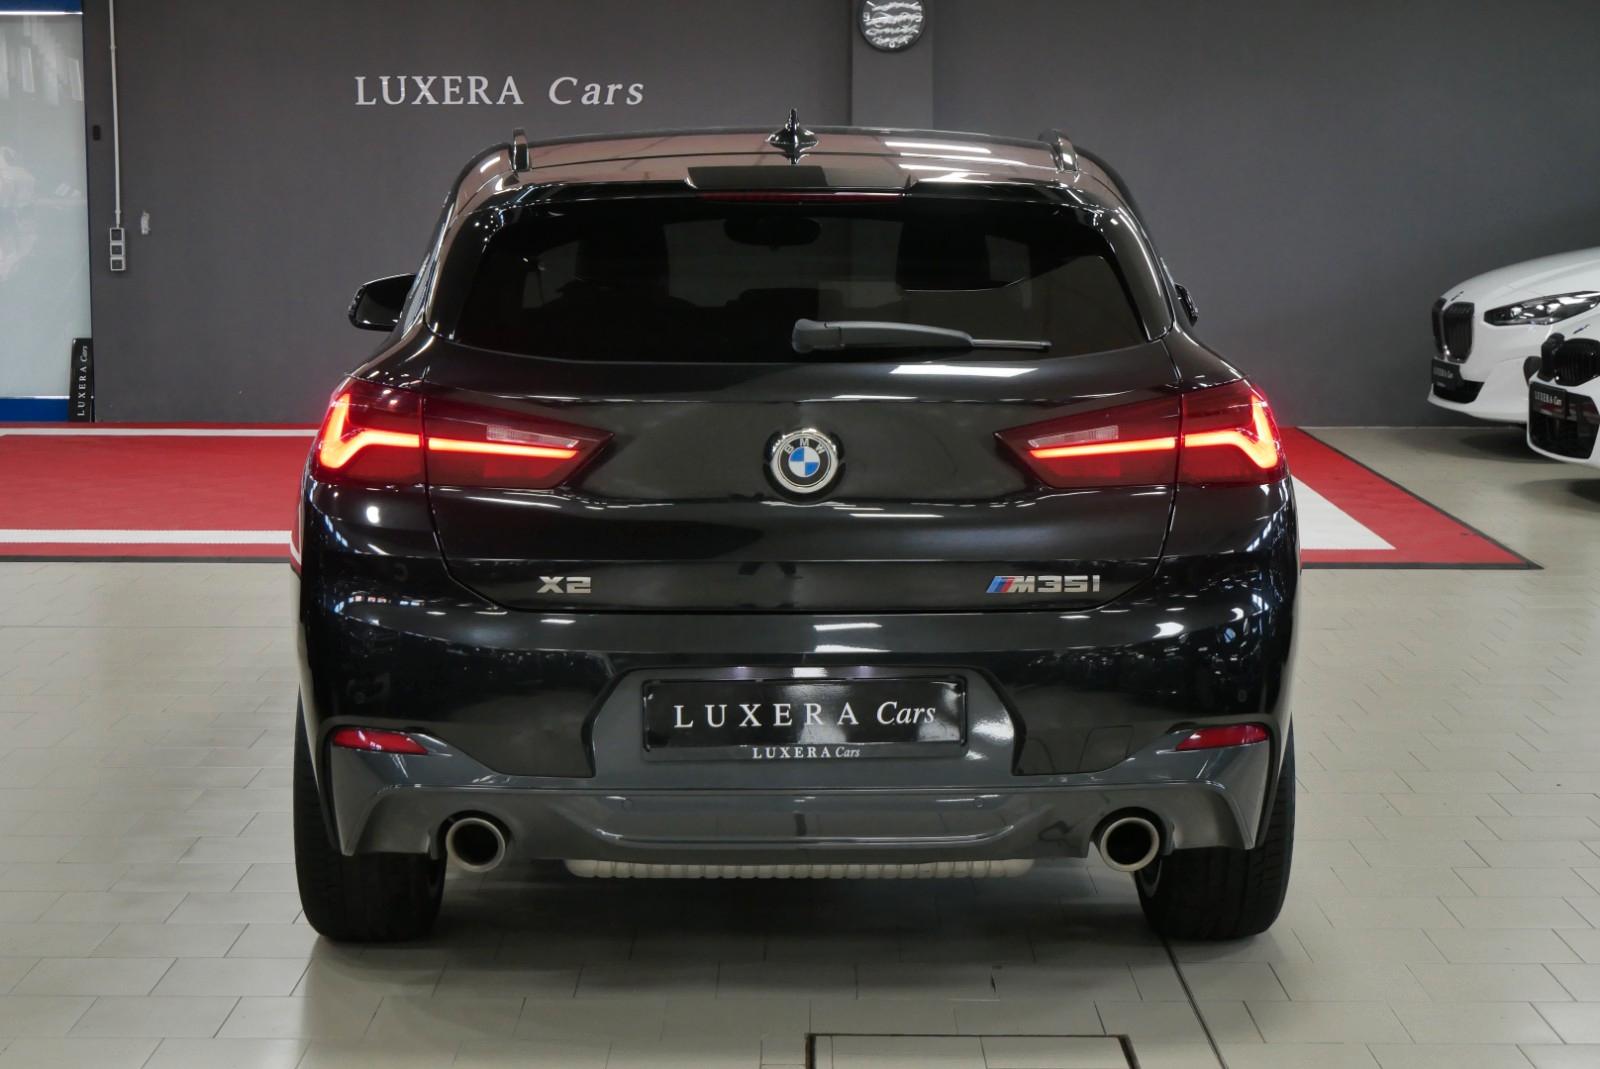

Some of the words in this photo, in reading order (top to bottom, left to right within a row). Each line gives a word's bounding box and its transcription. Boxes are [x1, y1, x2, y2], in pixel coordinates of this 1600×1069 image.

[354, 75, 524, 106] LUXERA
[548, 76, 645, 106] Cars
[77, 366, 87, 416] LUXERA
[784, 438, 826, 454] BMW
[536, 576, 592, 594] X2
[673, 703, 859, 728] LUXERA
[876, 701, 936, 725] Cars
[752, 747, 831, 759] LUXERA
[835, 747, 861, 758] Cars
